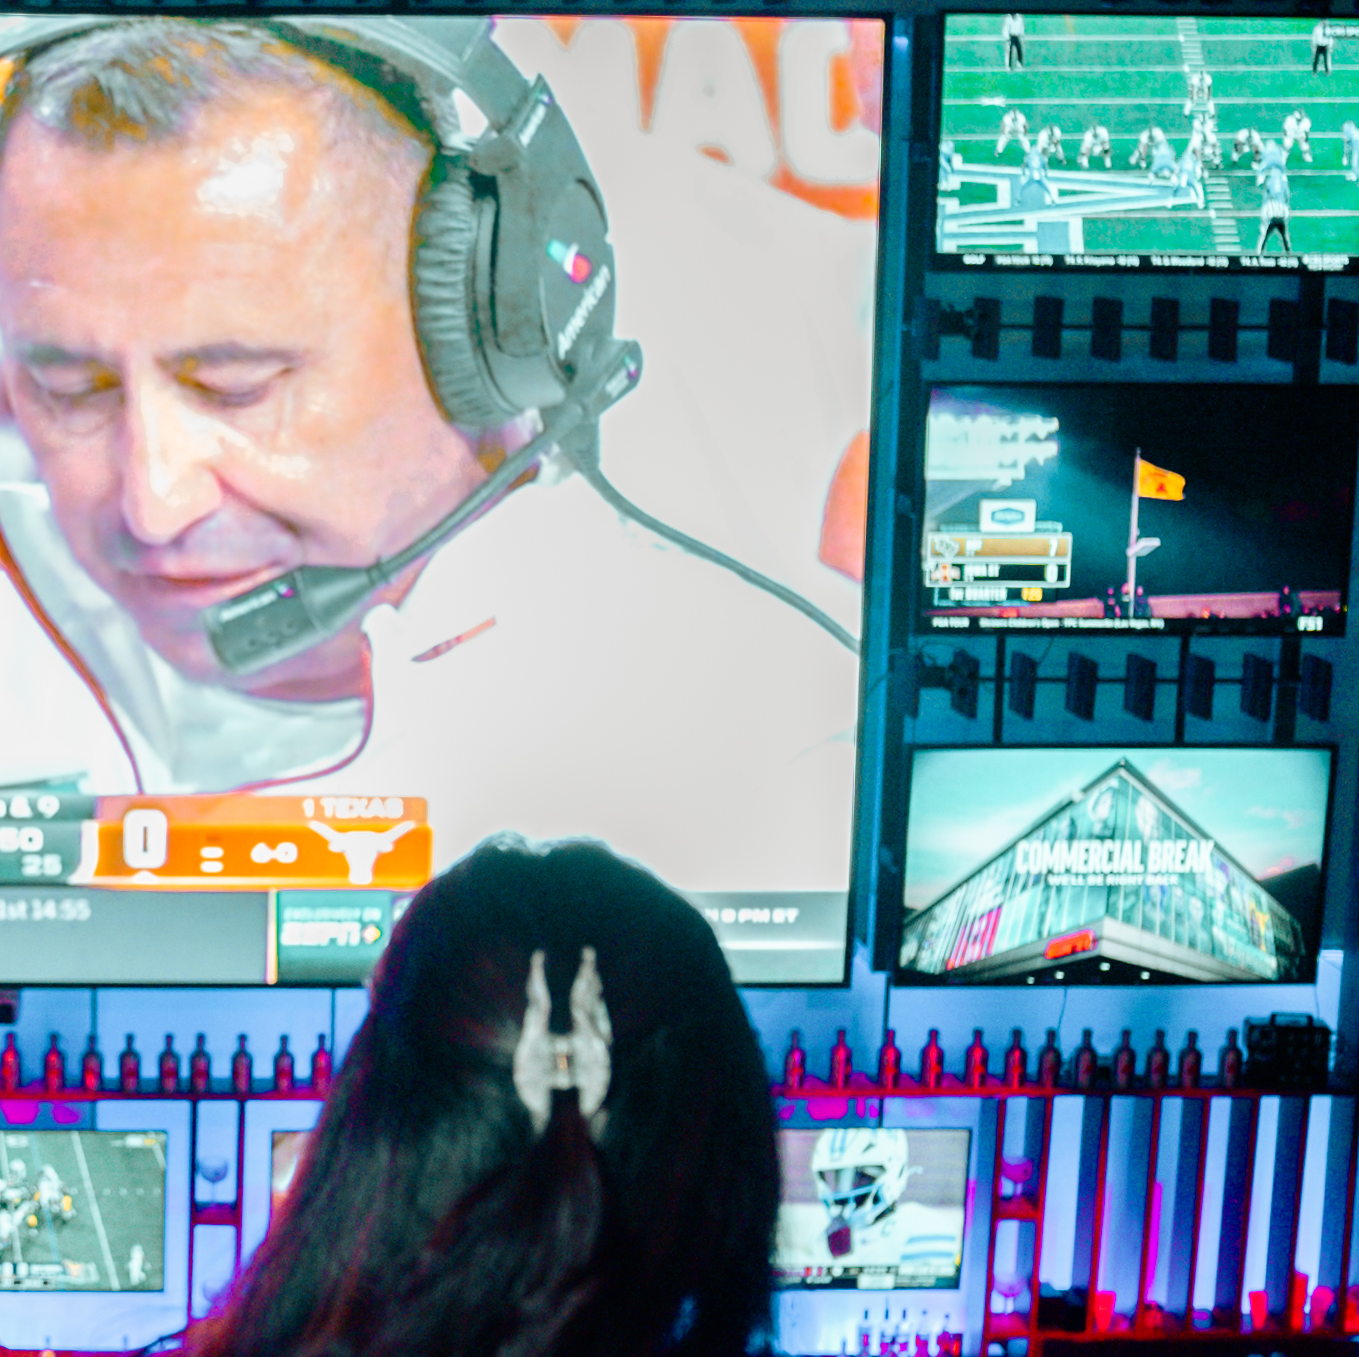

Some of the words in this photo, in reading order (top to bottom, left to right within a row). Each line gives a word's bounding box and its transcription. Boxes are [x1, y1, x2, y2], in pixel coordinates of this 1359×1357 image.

[1298, 616, 1323, 631] FS1
[321, 797, 404, 819] TEXAS
[123, 809, 168, 869] 0
[1016, 839, 1144, 874] COMMERCIAL
[1147, 840, 1215, 874] BREAK
